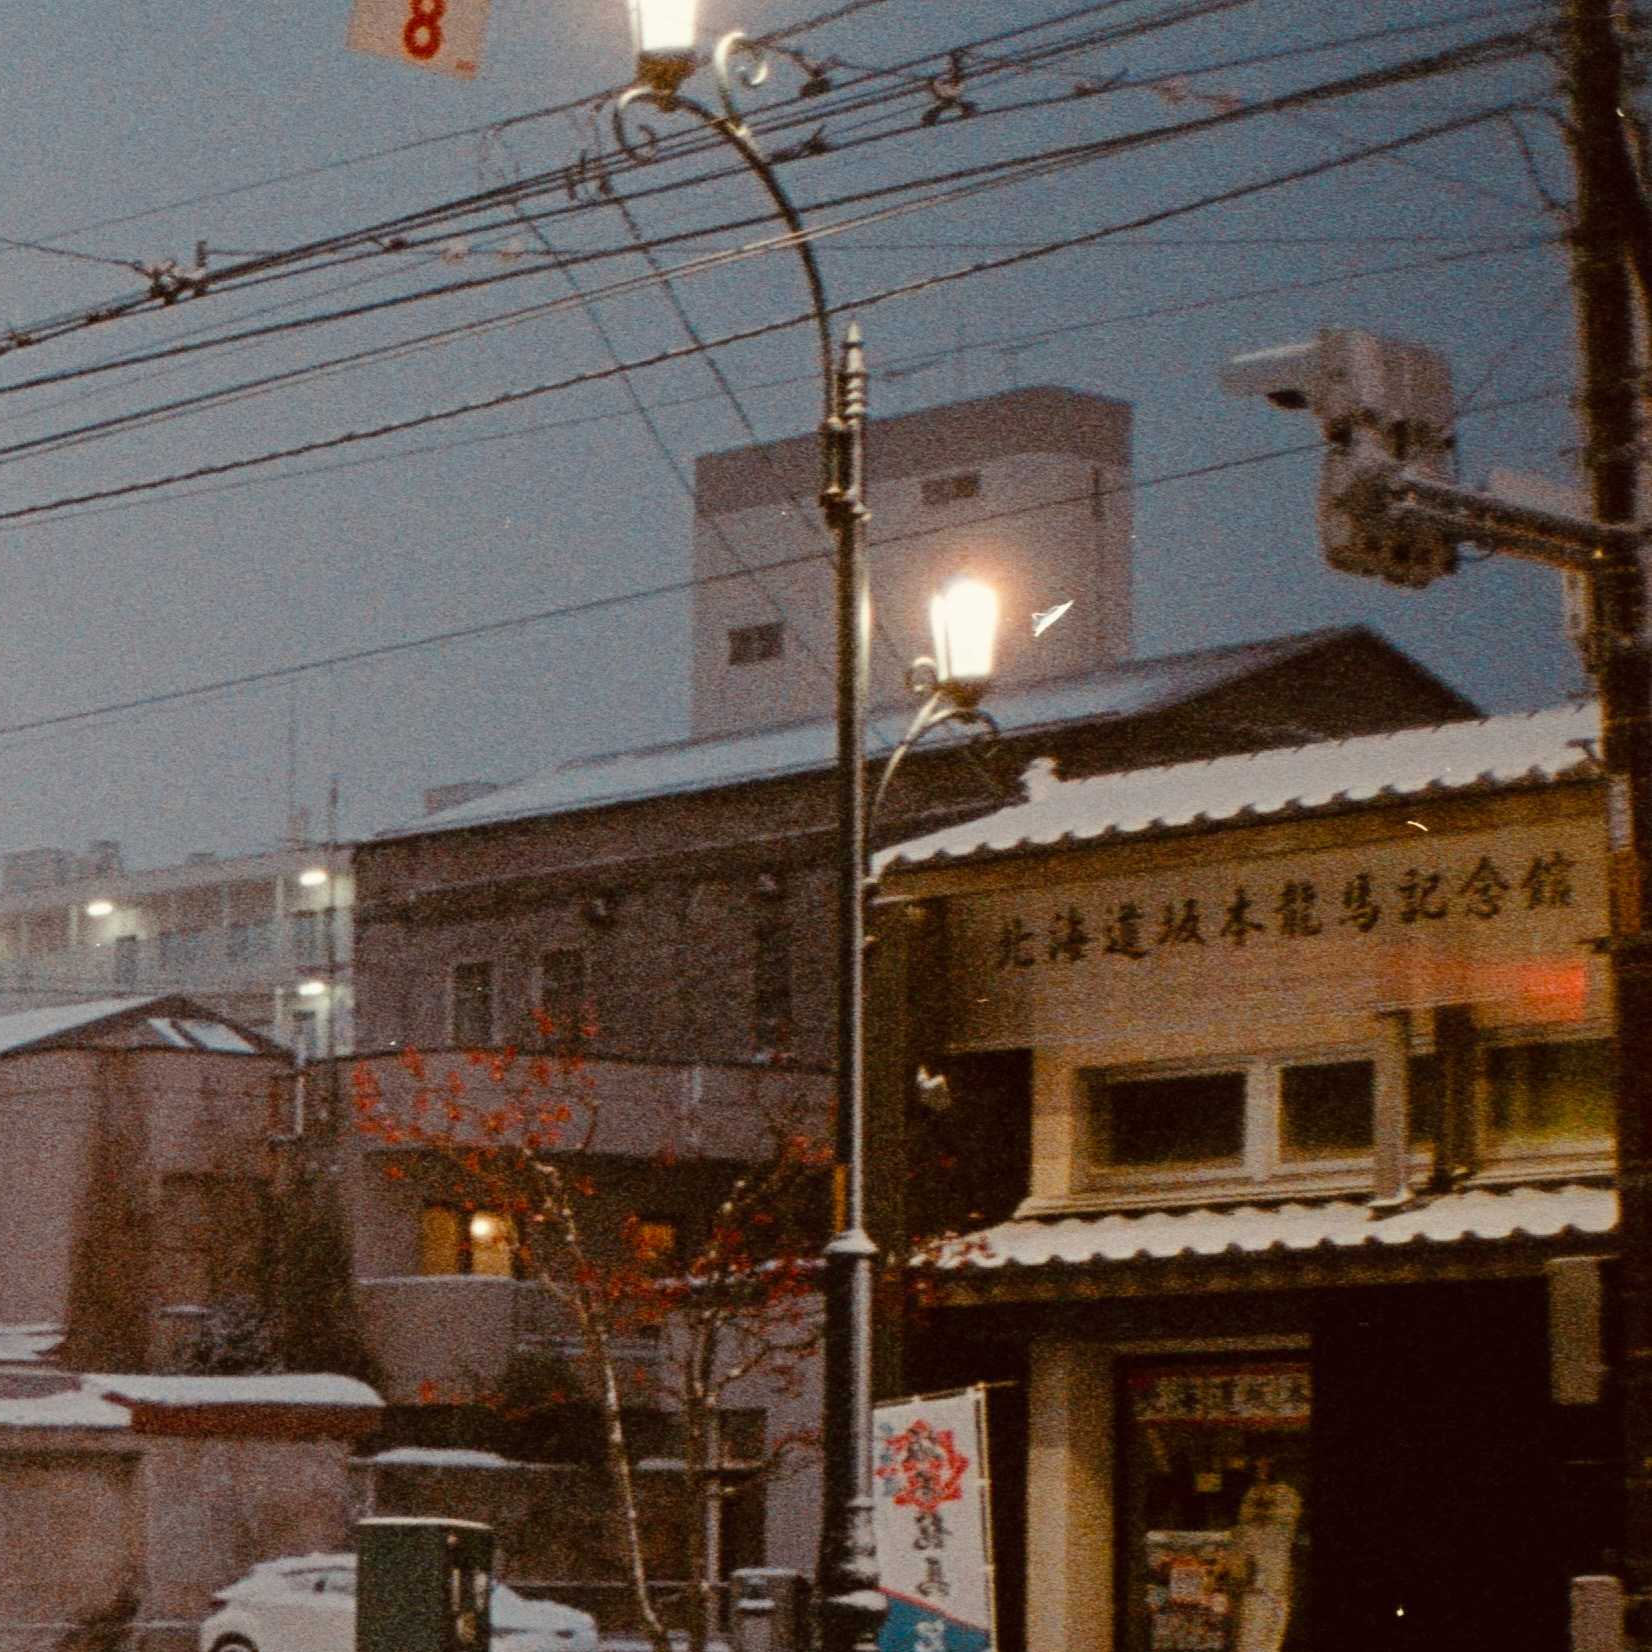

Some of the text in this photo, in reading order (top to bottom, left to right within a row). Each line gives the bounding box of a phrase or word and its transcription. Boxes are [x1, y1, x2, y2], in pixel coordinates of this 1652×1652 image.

[995, 850, 1576, 967] 北海道坂本龍馬記念館
